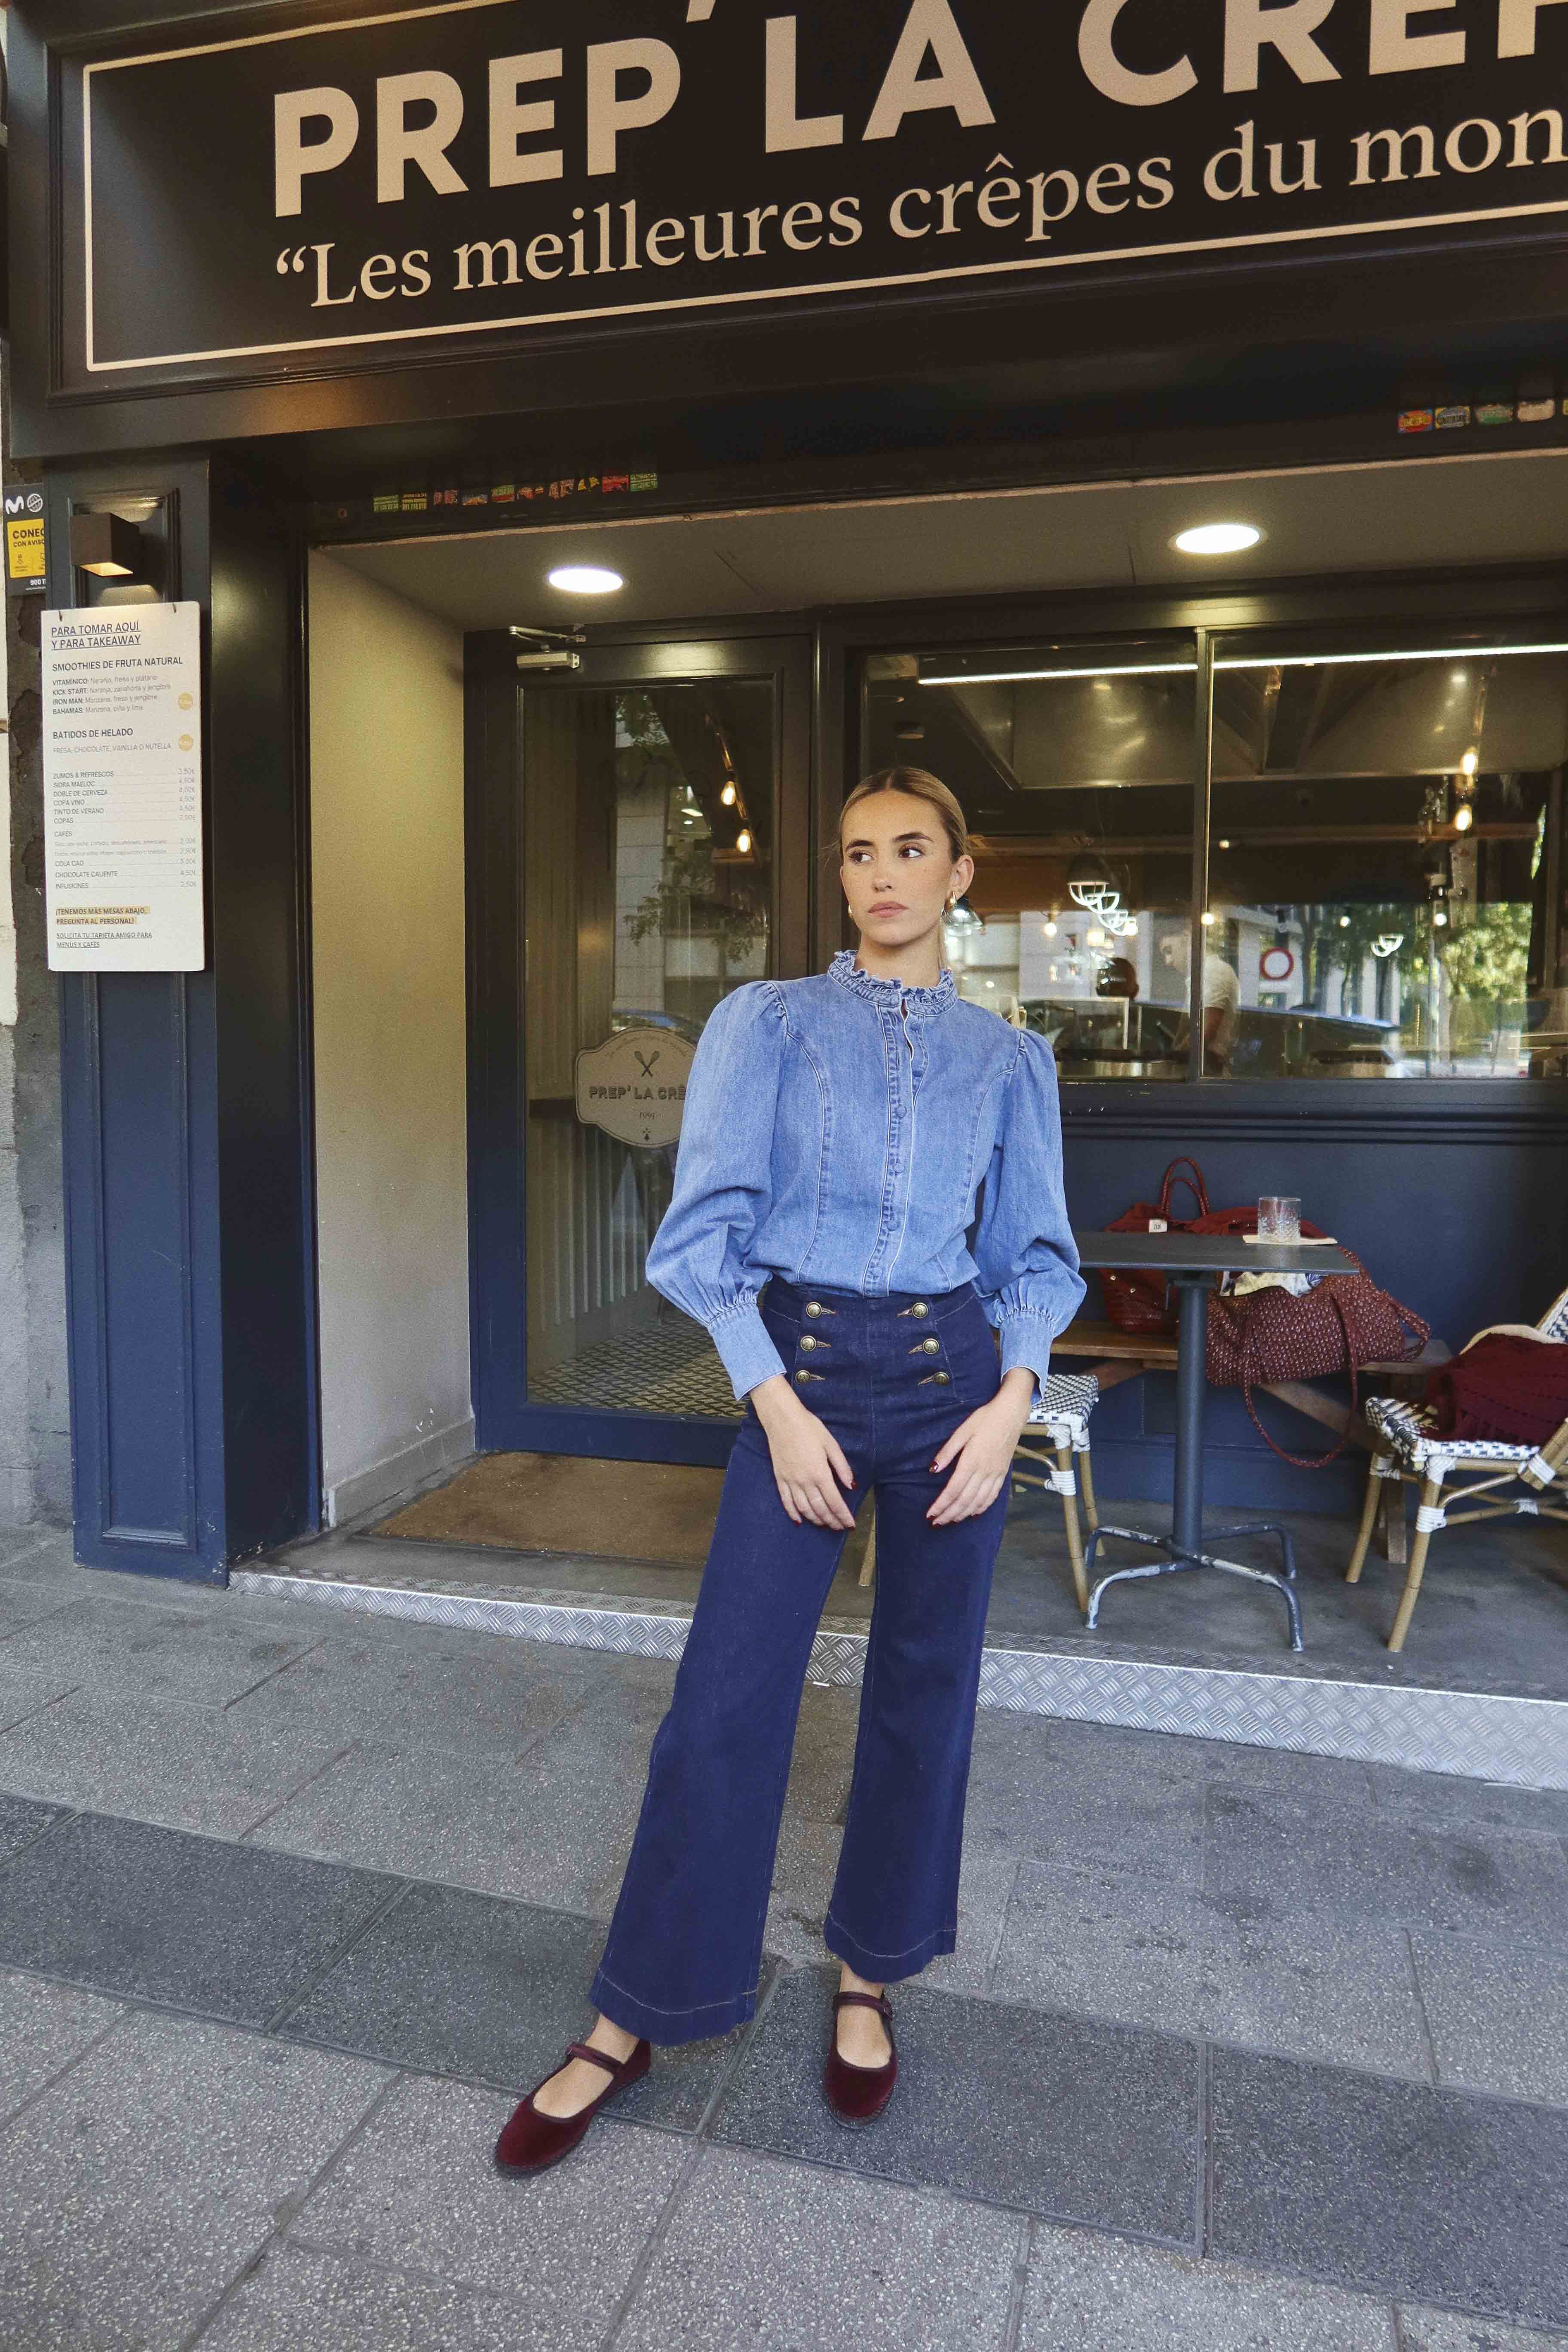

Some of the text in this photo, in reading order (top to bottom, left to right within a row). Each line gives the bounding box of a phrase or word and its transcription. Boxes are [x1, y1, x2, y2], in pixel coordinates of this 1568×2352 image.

[453, 197, 862, 291] meilleures
[890, 153, 1174, 242] crêpes
[1204, 120, 1322, 201] du
[51, 620, 139, 637] PARA TOMAR AQUÍ
[51, 635, 141, 649] Y PARA TAKEAWAY
[52, 661, 101, 671] SMOOTHIES
[116, 658, 142, 668] FRUTA
[144, 656, 183, 666] NATURAL
[53, 728, 134, 739] BATIDOS DE HELADO
